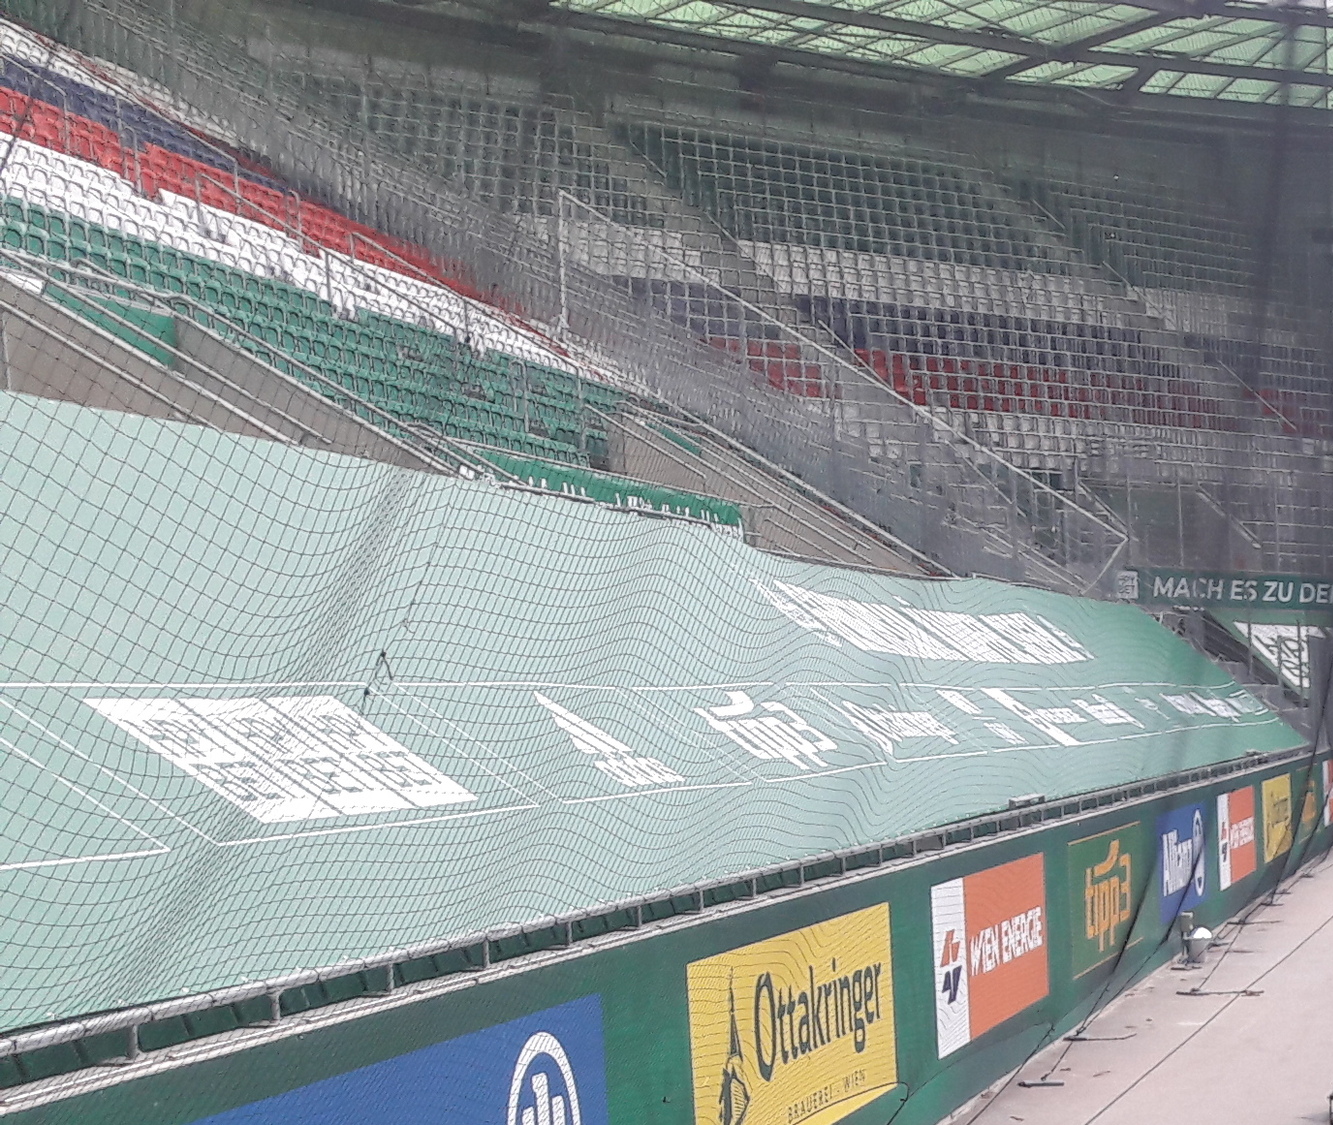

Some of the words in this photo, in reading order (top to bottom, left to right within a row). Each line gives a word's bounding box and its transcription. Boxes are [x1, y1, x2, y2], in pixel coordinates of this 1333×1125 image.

[1153, 576, 1223, 600] MACH
[1229, 579, 1258, 601] ES
[1262, 581, 1294, 603] ZU
[1083, 840, 1132, 951] tipp3
[969, 931, 1000, 977] WIEN
[1000, 906, 1044, 965] ENERGIE
[753, 957, 883, 1082] Ottakringer
